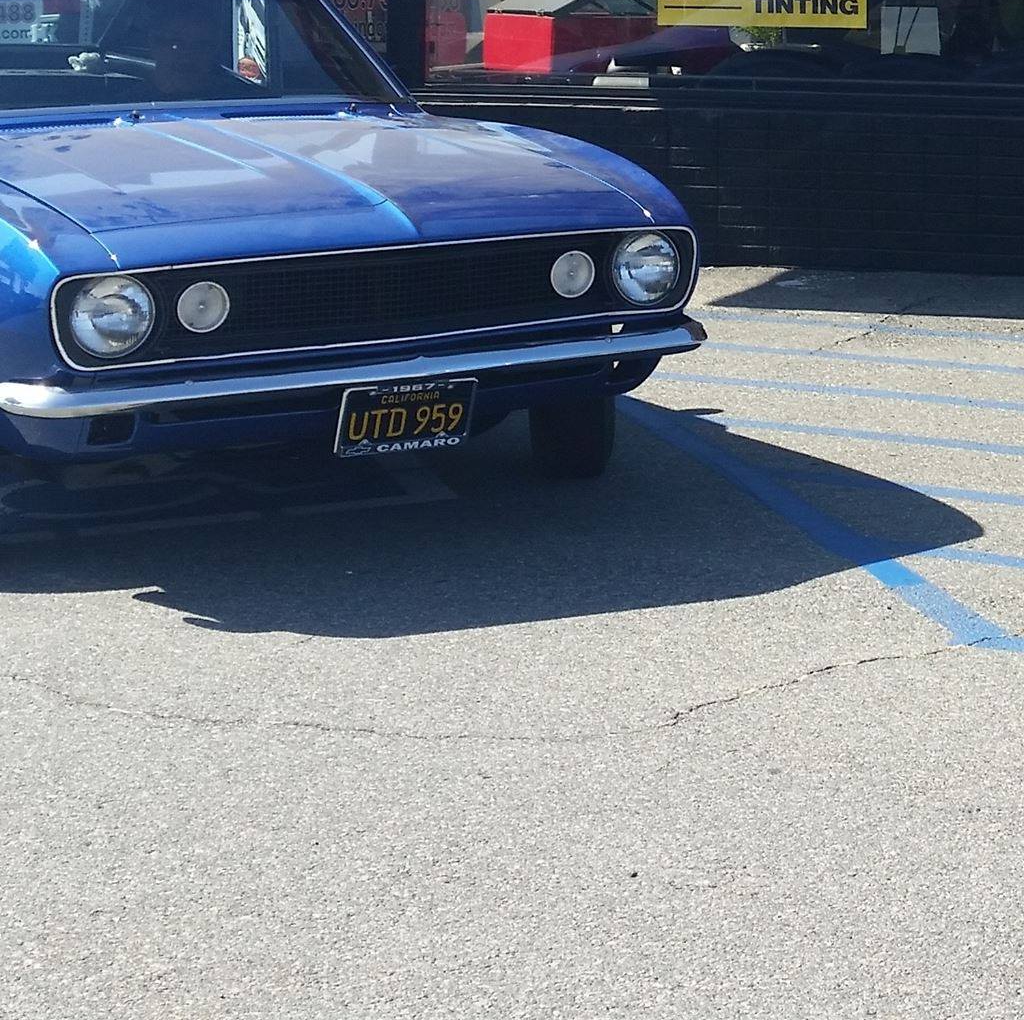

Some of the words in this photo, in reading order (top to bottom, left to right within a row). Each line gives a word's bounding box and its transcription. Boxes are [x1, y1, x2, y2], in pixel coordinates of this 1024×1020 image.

[381, 391, 441, 405] CALIFORNIA
[348, 408, 408, 441] UTD
[413, 403, 464, 435] 959
[376, 437, 461, 453] CAMARO
